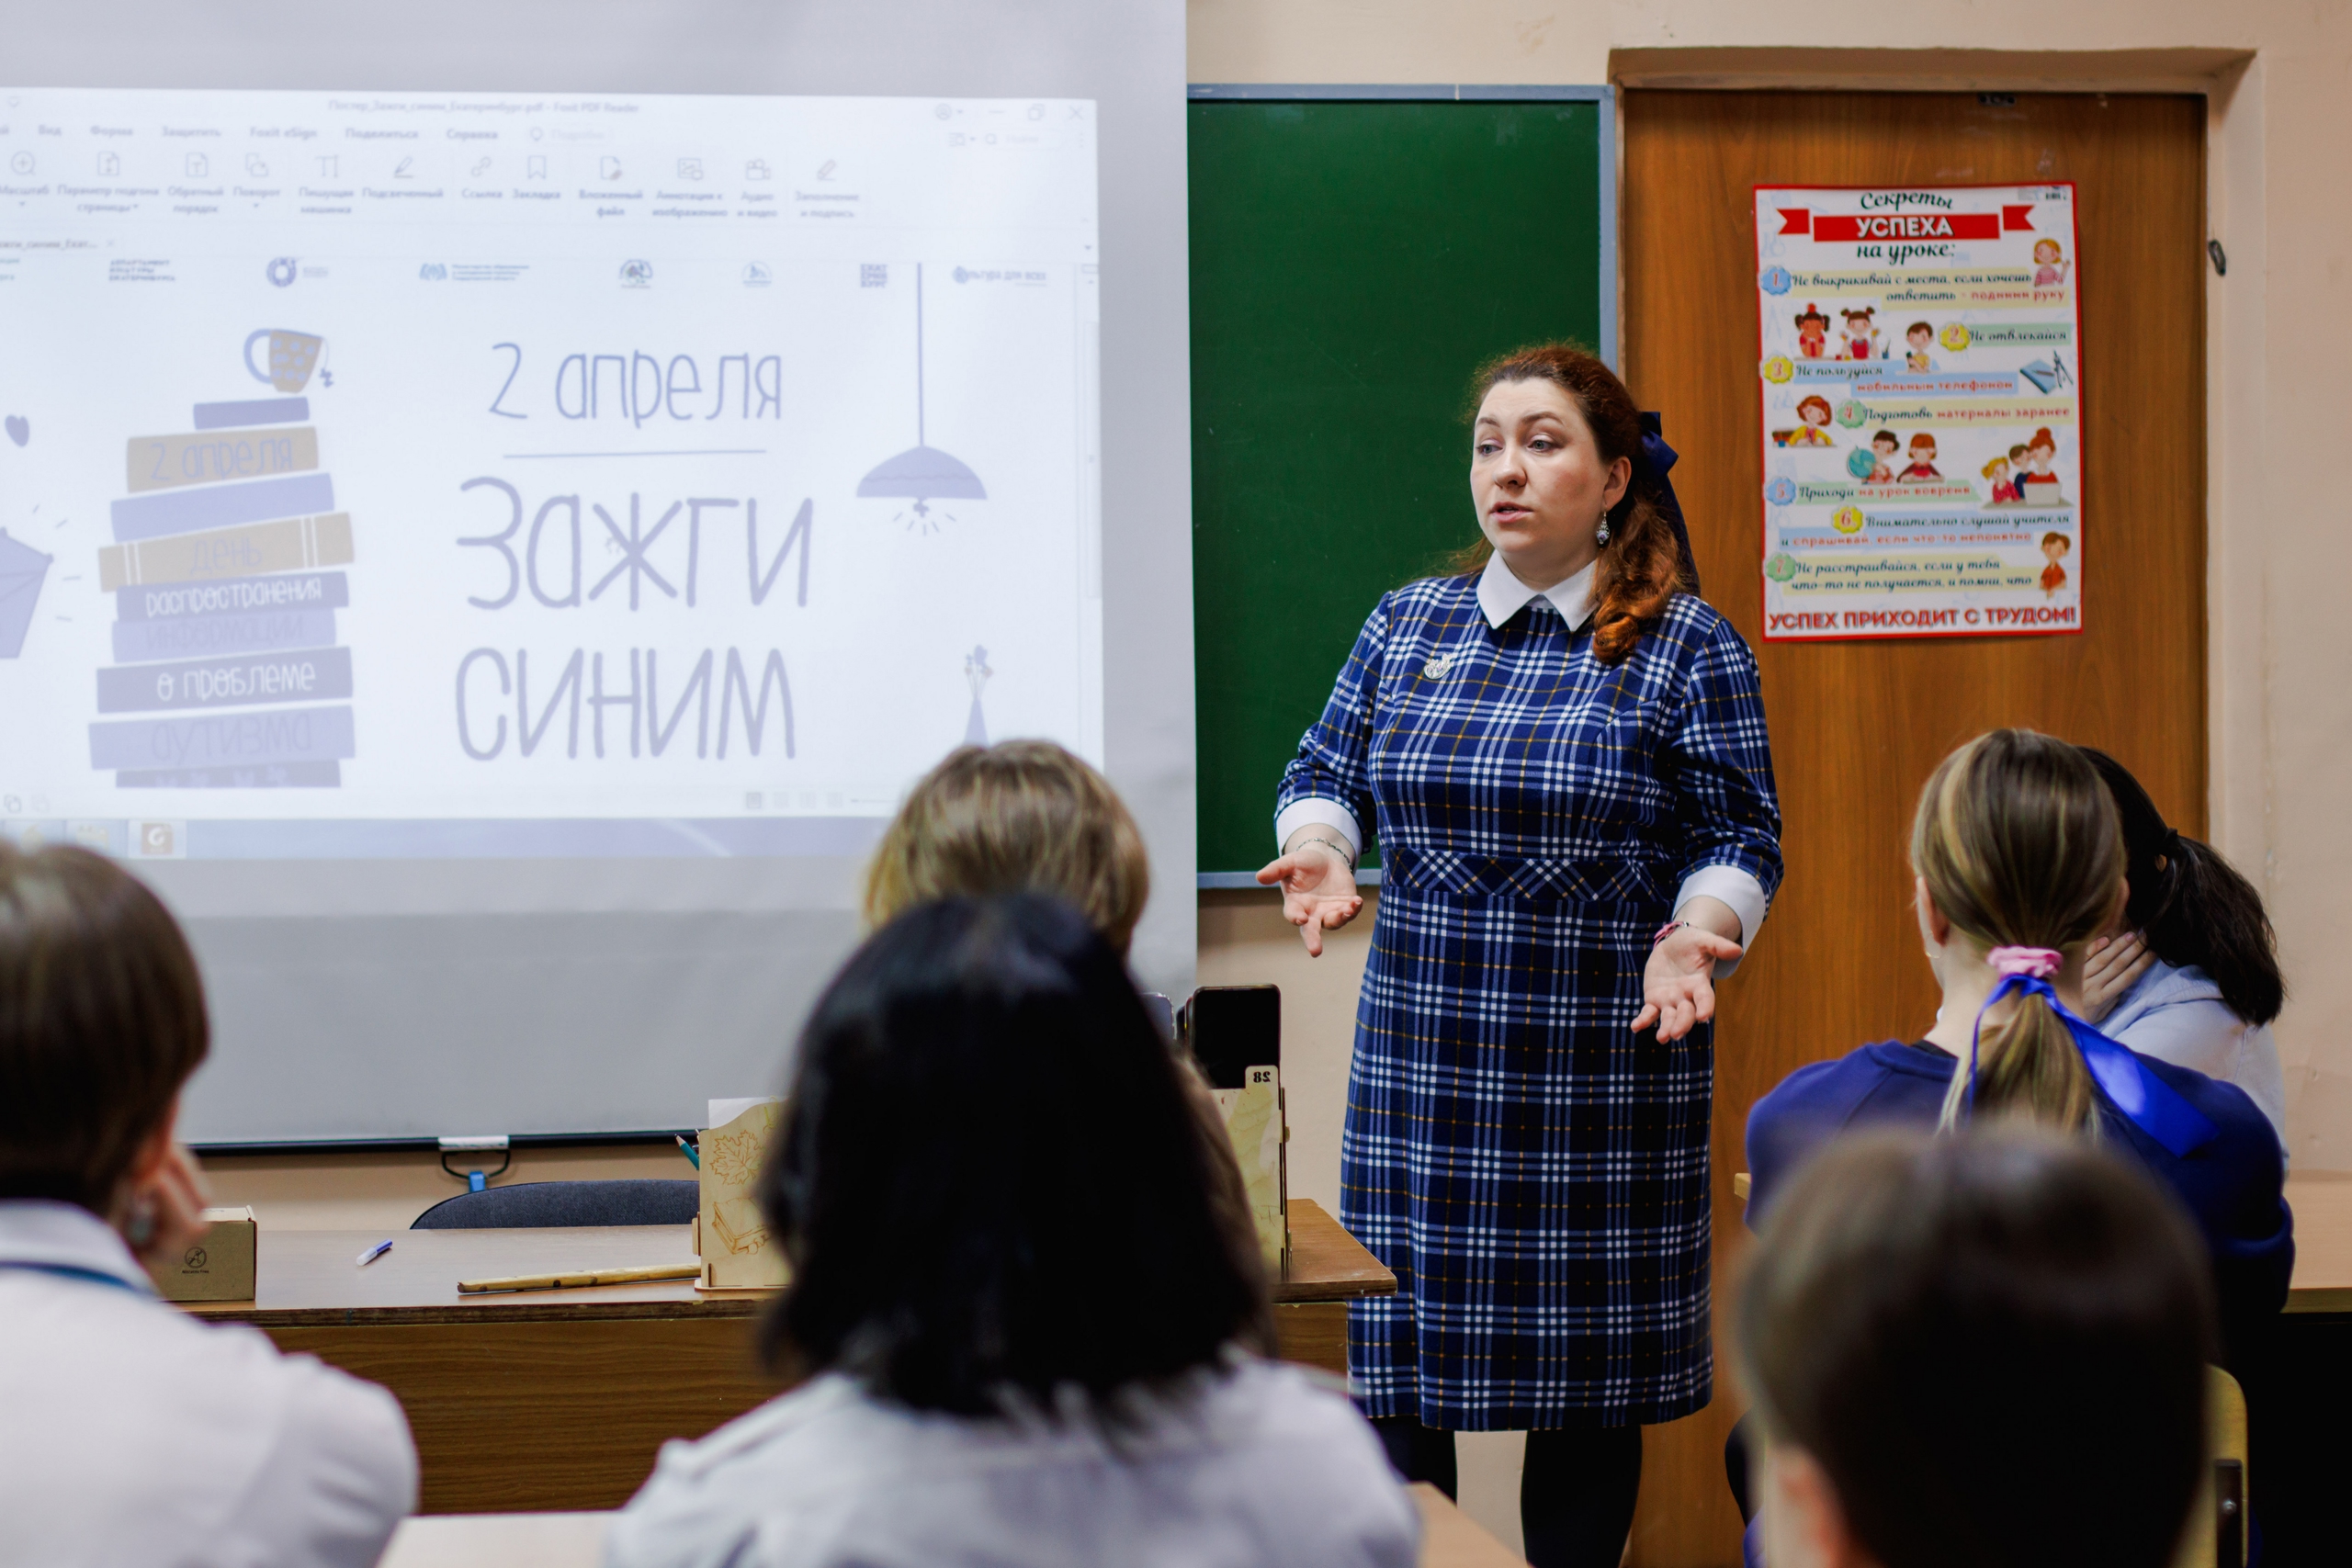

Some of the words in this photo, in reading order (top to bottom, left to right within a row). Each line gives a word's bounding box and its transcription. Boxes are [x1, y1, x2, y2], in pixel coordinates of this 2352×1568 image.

[554, 102, 578, 112] Foxit
[582, 102, 600, 112] PDF
[605, 102, 639, 113] Reader
[39, 124, 62, 136] Вид
[90, 125, 133, 139] Форма
[163, 126, 221, 137] Защитить
[250, 127, 279, 137] Foxit
[284, 127, 317, 141] eSign
[345, 127, 419, 139] Поделиться
[447, 129, 498, 141] Справка
[168, 186, 223, 197] Обратный
[233, 186, 280, 198] Поворот
[299, 186, 354, 200] Пишущая
[362, 187, 444, 198] Подсвеченный
[461, 187, 503, 199] Ссылка
[513, 188, 560, 200] Закладка
[579, 188, 643, 200] Вложенный
[656, 190, 715, 202] Аннотация
[741, 191, 774, 204] Аудио
[795, 190, 859, 202] Заполнение
[1860, 190, 1953, 212] Секреты
[173, 205, 219, 215] порядок
[597, 207, 625, 219] файл
[652, 207, 728, 219] изображению
[747, 209, 777, 220] видео
[810, 209, 855, 220] подпись
[1856, 216, 1955, 239] УСПЕХА
[1856, 243, 1883, 258] на
[1888, 243, 1956, 266] уроке:
[1772, 272, 1783, 288] 1.
[1792, 275, 1809, 286] Не
[1813, 273, 1892, 290] выкрикивай
[1895, 276, 1902, 285] с
[1905, 275, 1951, 286] места,
[1954, 275, 1984, 284] если
[1984, 273, 2032, 283] хочешь
[1886, 288, 1956, 301] ответить
[1972, 290, 2030, 301] подними
[2033, 290, 2064, 302] руку
[1948, 325, 1964, 344] 2.
[1969, 330, 1983, 342] Не
[1988, 327, 2067, 342] отвлекайся
[1771, 361, 1788, 378] 3.
[1796, 365, 1814, 377] Не
[1816, 363, 1883, 380] пользуйся
[489, 342, 527, 420] 2
[556, 349, 781, 429] апреля
[1857, 380, 1934, 392] мобильным
[1939, 379, 2014, 393] телефоном
[1862, 405, 1933, 424] Подготовь
[1938, 409, 2011, 423] материалы
[2016, 408, 2070, 420] заранее
[151, 442, 171, 482] 2
[184, 436, 294, 481] апреля
[1775, 482, 1791, 500] 5.
[1798, 485, 1855, 502] Приходи
[1859, 488, 1874, 497] на
[1879, 487, 1910, 500] урок
[1915, 486, 1970, 498] вовремя
[1840, 510, 1857, 528] 6.
[1865, 515, 1958, 528] Внимательно
[1961, 513, 2009, 531] слушай
[2013, 514, 2070, 530] учителя
[1781, 538, 1790, 547] и
[1792, 534, 1873, 549] спрашивай,
[1877, 535, 1909, 545] если
[1913, 533, 1957, 544] что-то
[1960, 532, 2031, 543] непонятно
[189, 535, 263, 577] день
[1795, 562, 1813, 574] Не
[1815, 559, 1921, 577] расстраивайся,
[1925, 560, 1952, 570] если
[1956, 561, 1963, 575] у
[1967, 557, 2001, 570] тебя
[1792, 581, 1843, 591] что-то
[1847, 581, 1861, 590] не
[1864, 579, 1945, 593] получается,
[1948, 578, 1956, 587] и
[1959, 577, 2004, 588] помни,
[2007, 576, 2032, 586] что
[146, 576, 322, 618] распространения
[1768, 611, 1839, 630] УСПЕХ
[1843, 608, 1960, 628] ПРИХОДИТ
[1963, 607, 1979, 626] С
[1984, 605, 2077, 626] ТРУДОМ!
[145, 614, 304, 651] информации
[157, 671, 175, 701] о
[184, 662, 316, 702] проблеме
[152, 711, 312, 768] аутизма
